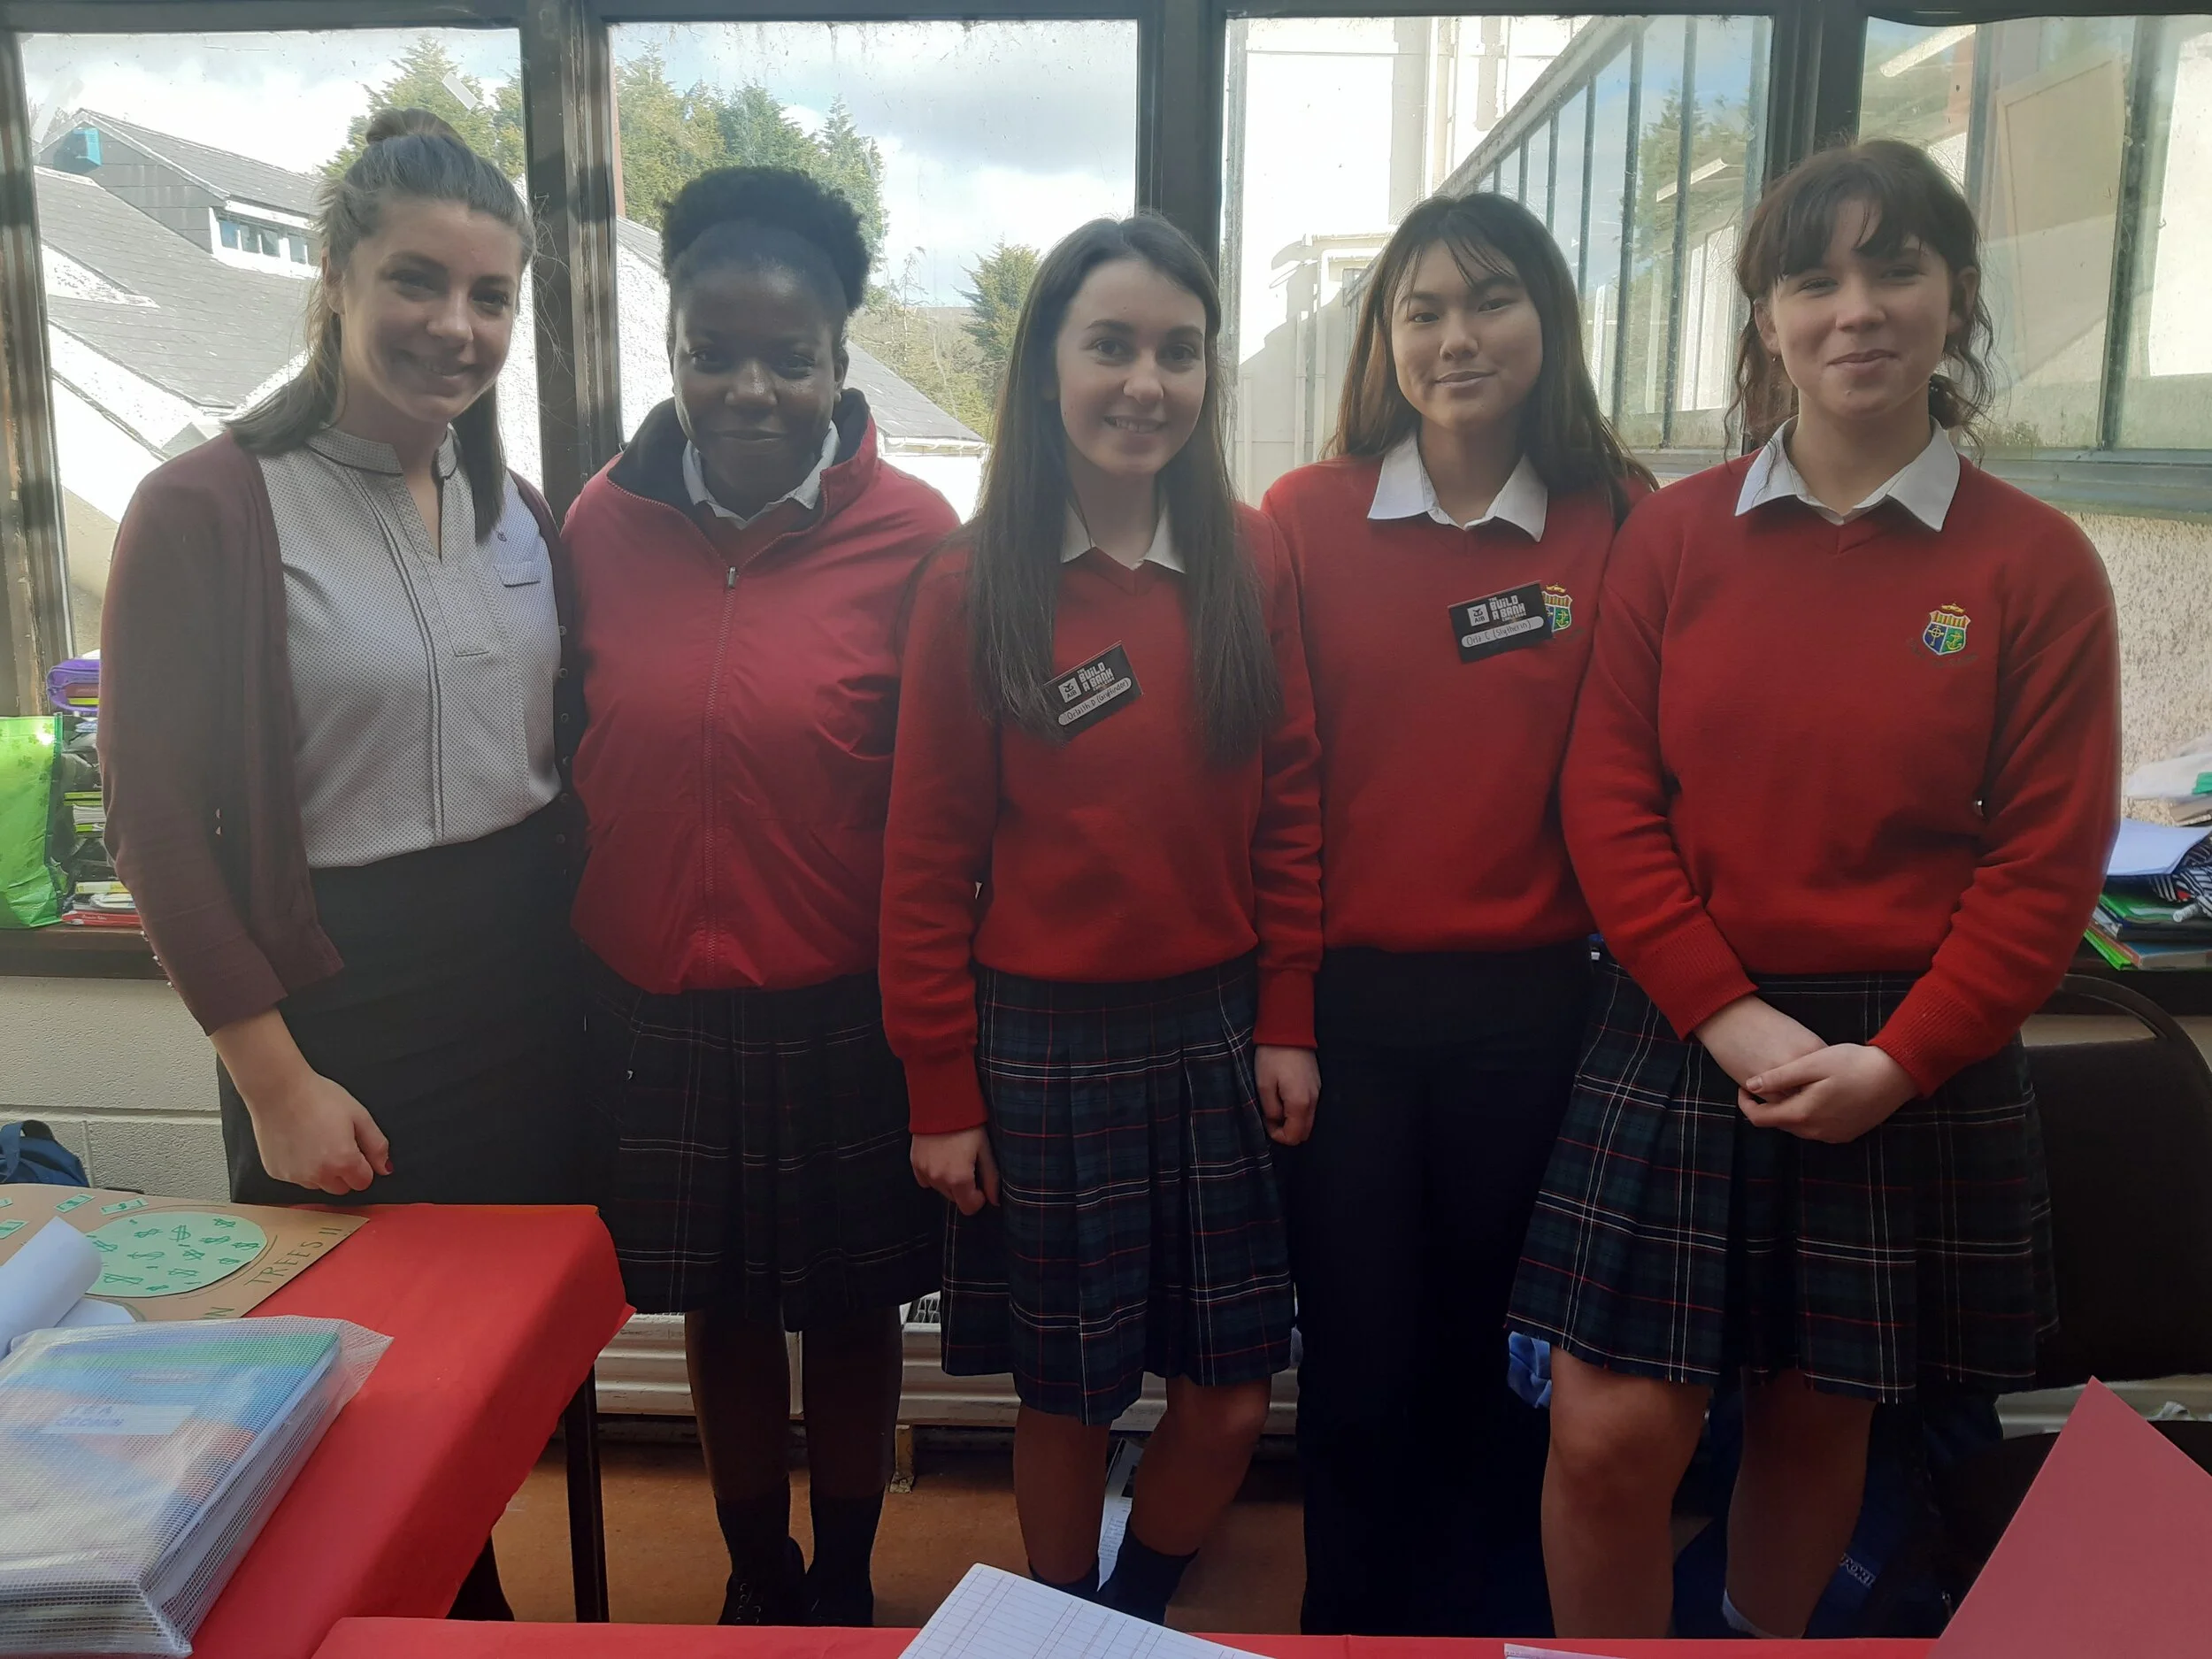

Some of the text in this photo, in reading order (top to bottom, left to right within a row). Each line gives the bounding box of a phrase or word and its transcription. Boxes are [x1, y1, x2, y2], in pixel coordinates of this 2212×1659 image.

[1491, 603, 1526, 620] A BANK
[1081, 667, 1115, 692] A BANK
[1066, 690, 1078, 699] AIB
